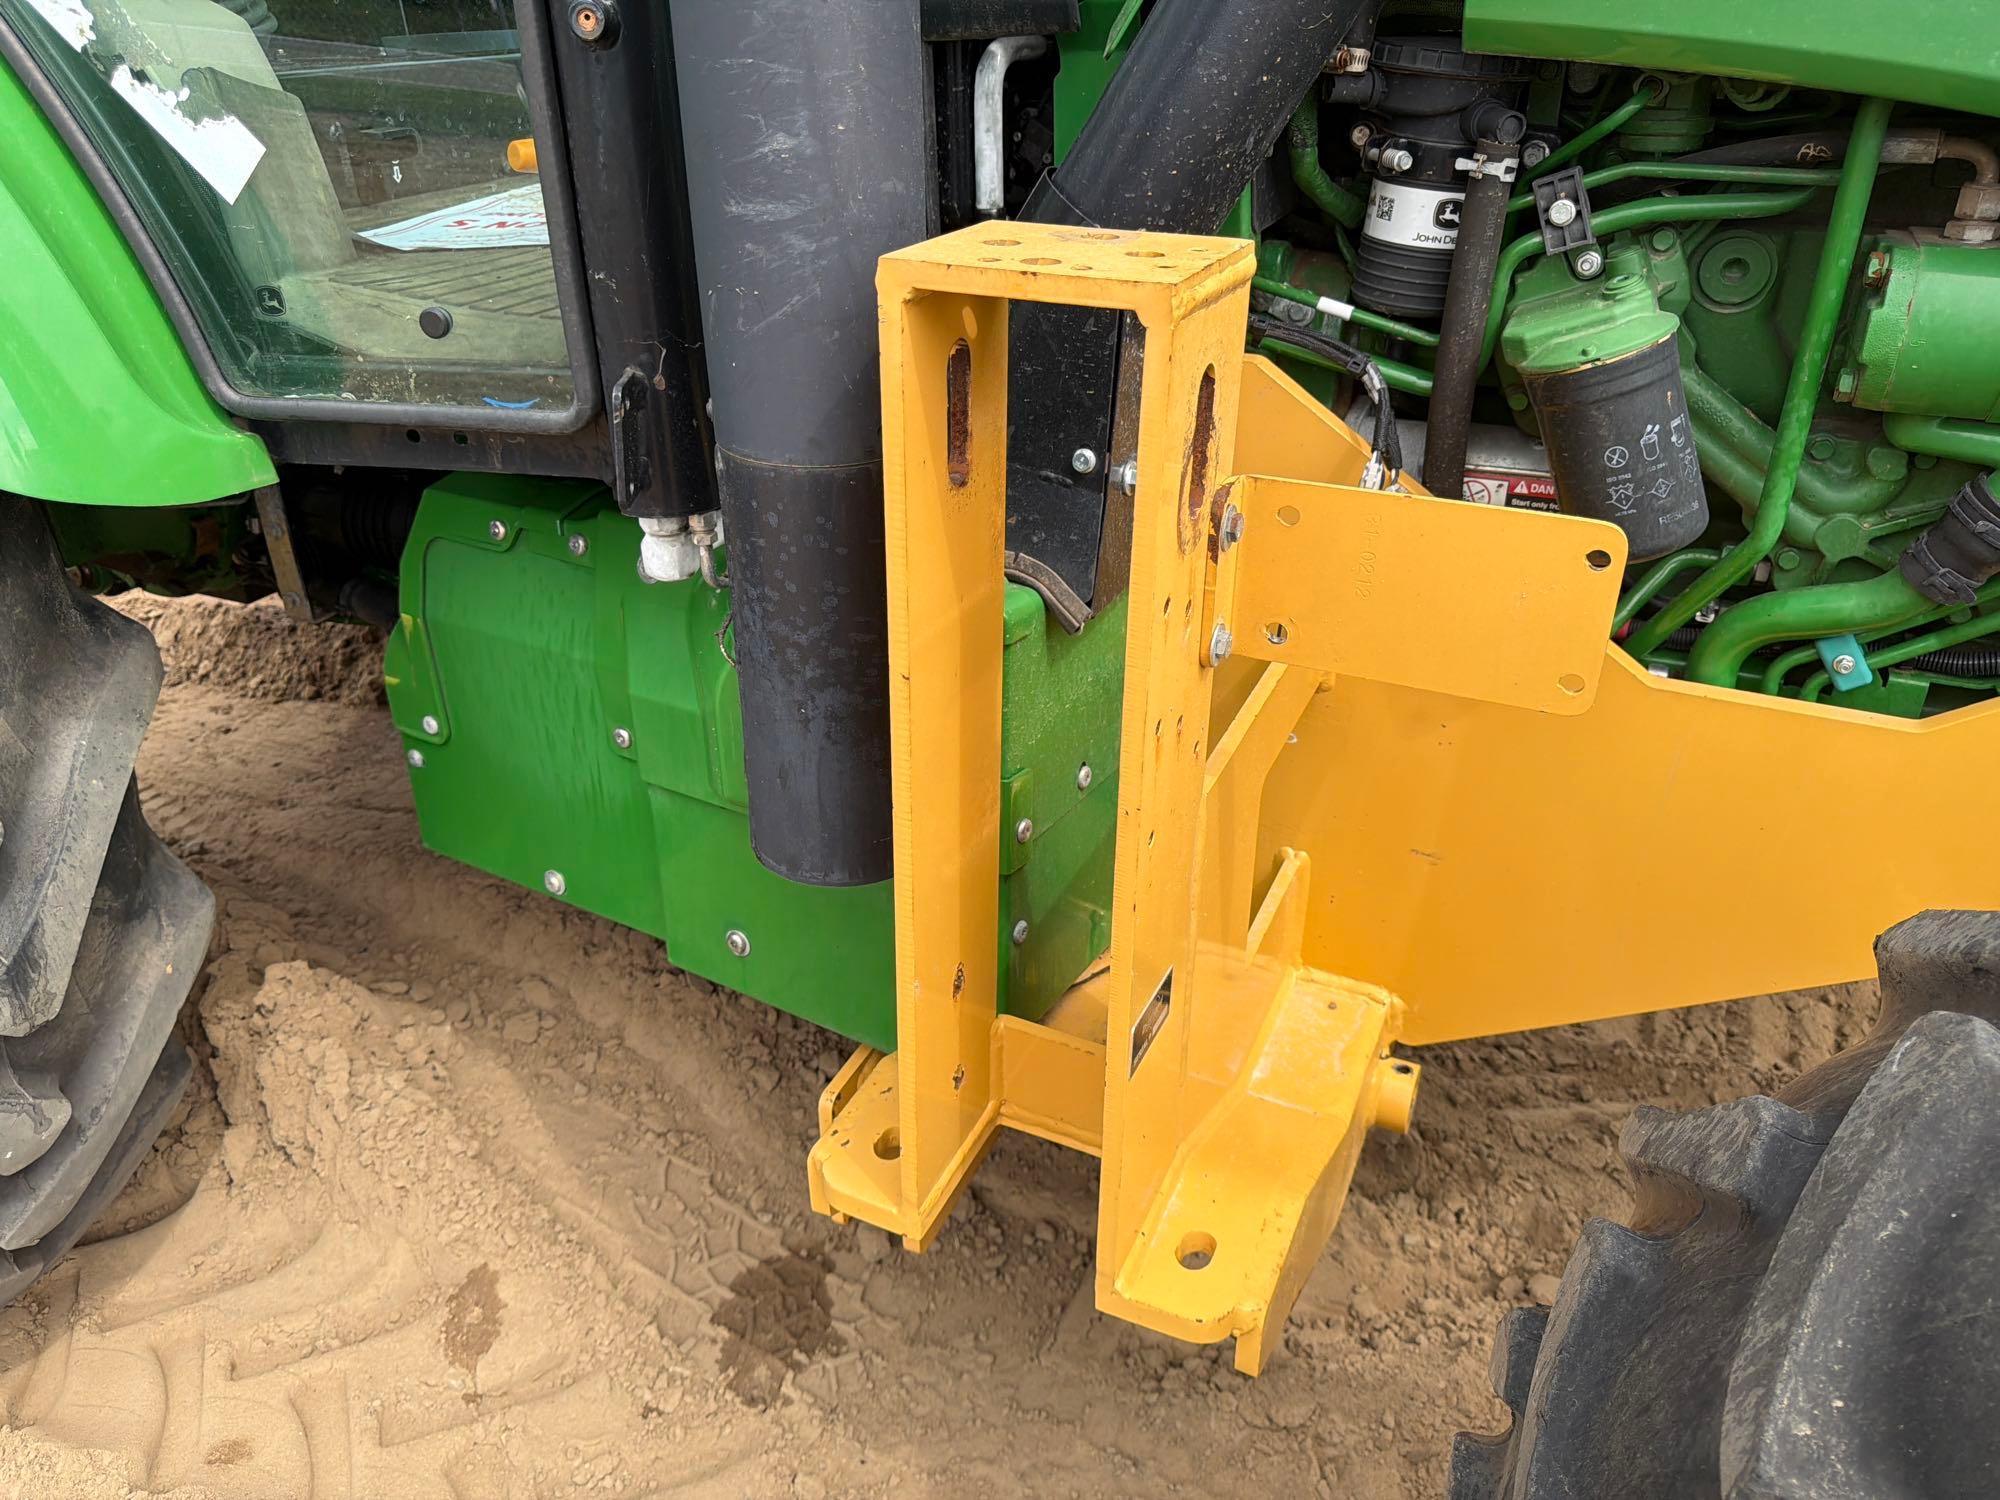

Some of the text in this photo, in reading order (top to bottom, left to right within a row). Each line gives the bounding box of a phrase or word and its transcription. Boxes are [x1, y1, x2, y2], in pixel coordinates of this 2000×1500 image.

[1412, 232, 1441, 244] JOHN
[1511, 498, 1530, 507] Start
[1531, 501, 1549, 510] only
